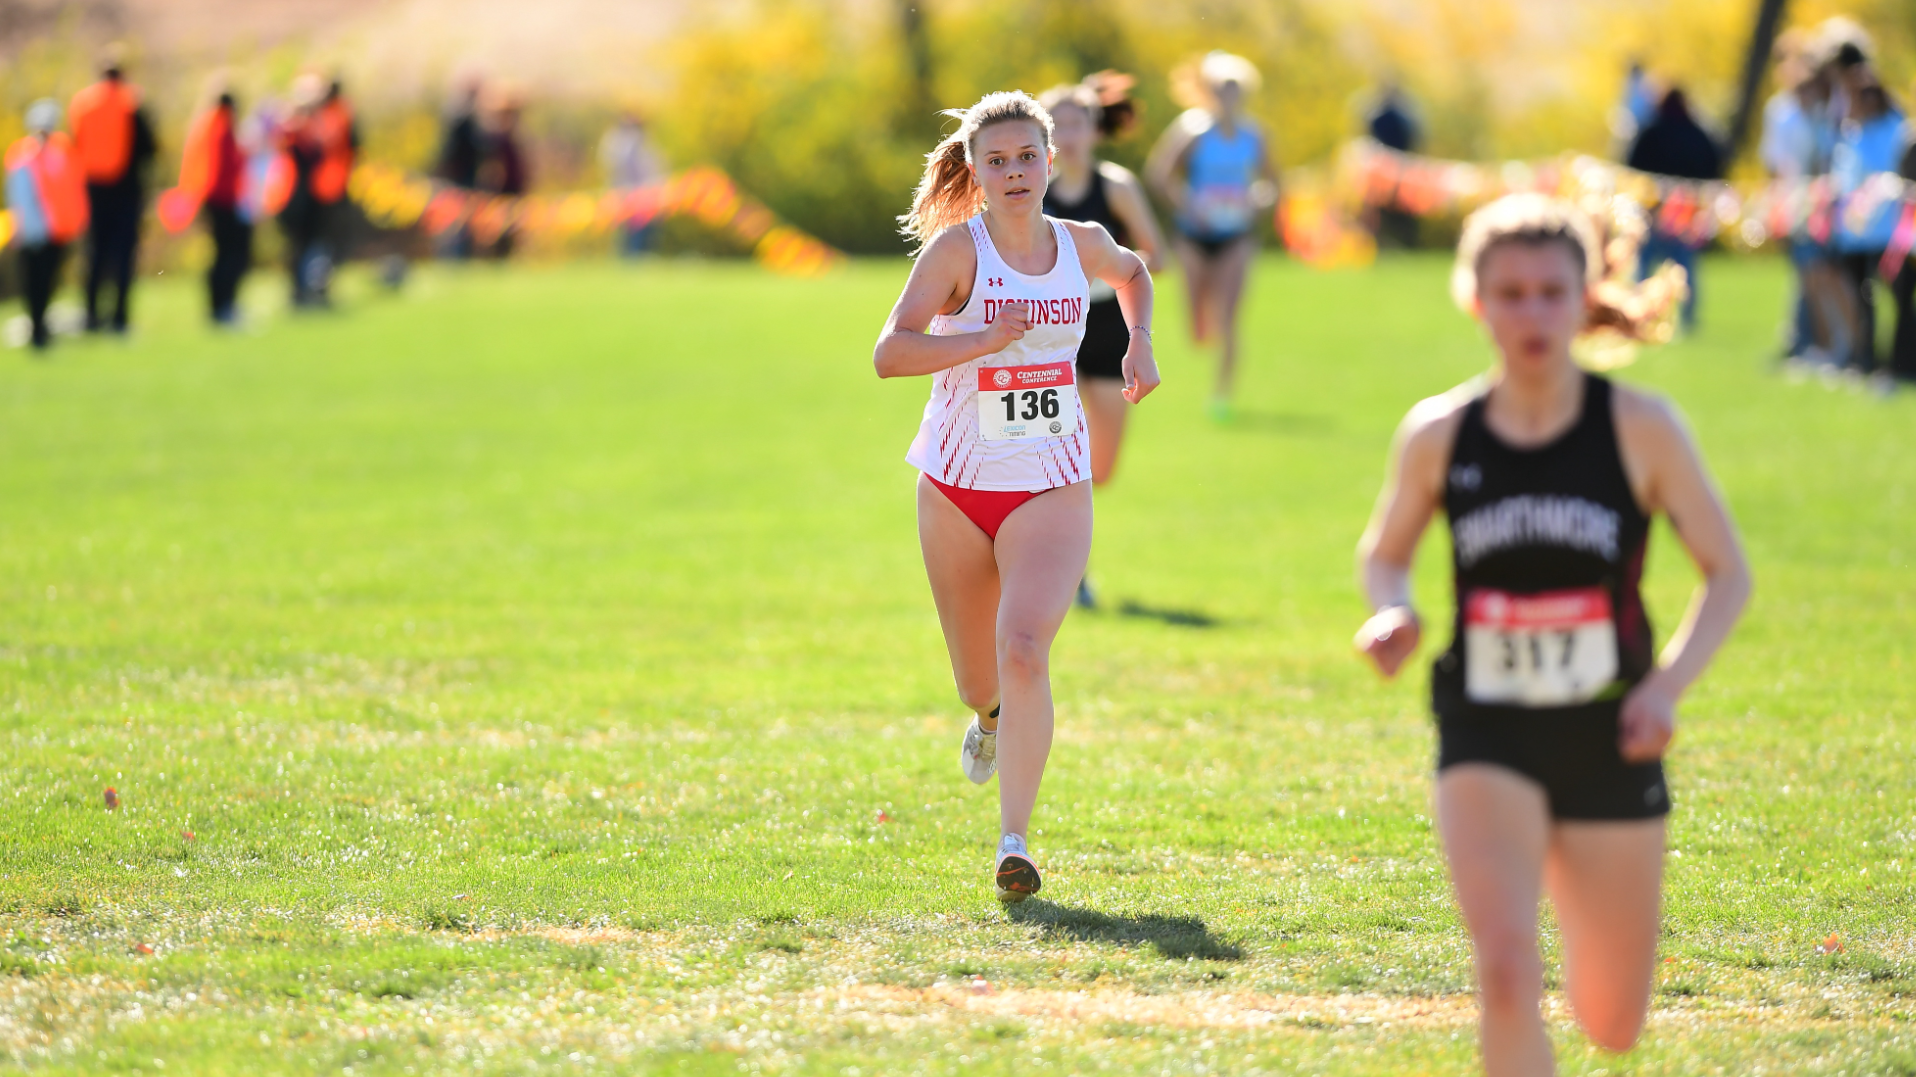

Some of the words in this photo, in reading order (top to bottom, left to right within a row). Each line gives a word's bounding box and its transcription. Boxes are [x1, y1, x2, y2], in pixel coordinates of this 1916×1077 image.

[983, 297, 1081, 325] DINSON
[1017, 368, 1062, 379] CENTENNIAL
[1022, 376, 1057, 384] CONFERENCE
[1001, 389, 1060, 421] 136
